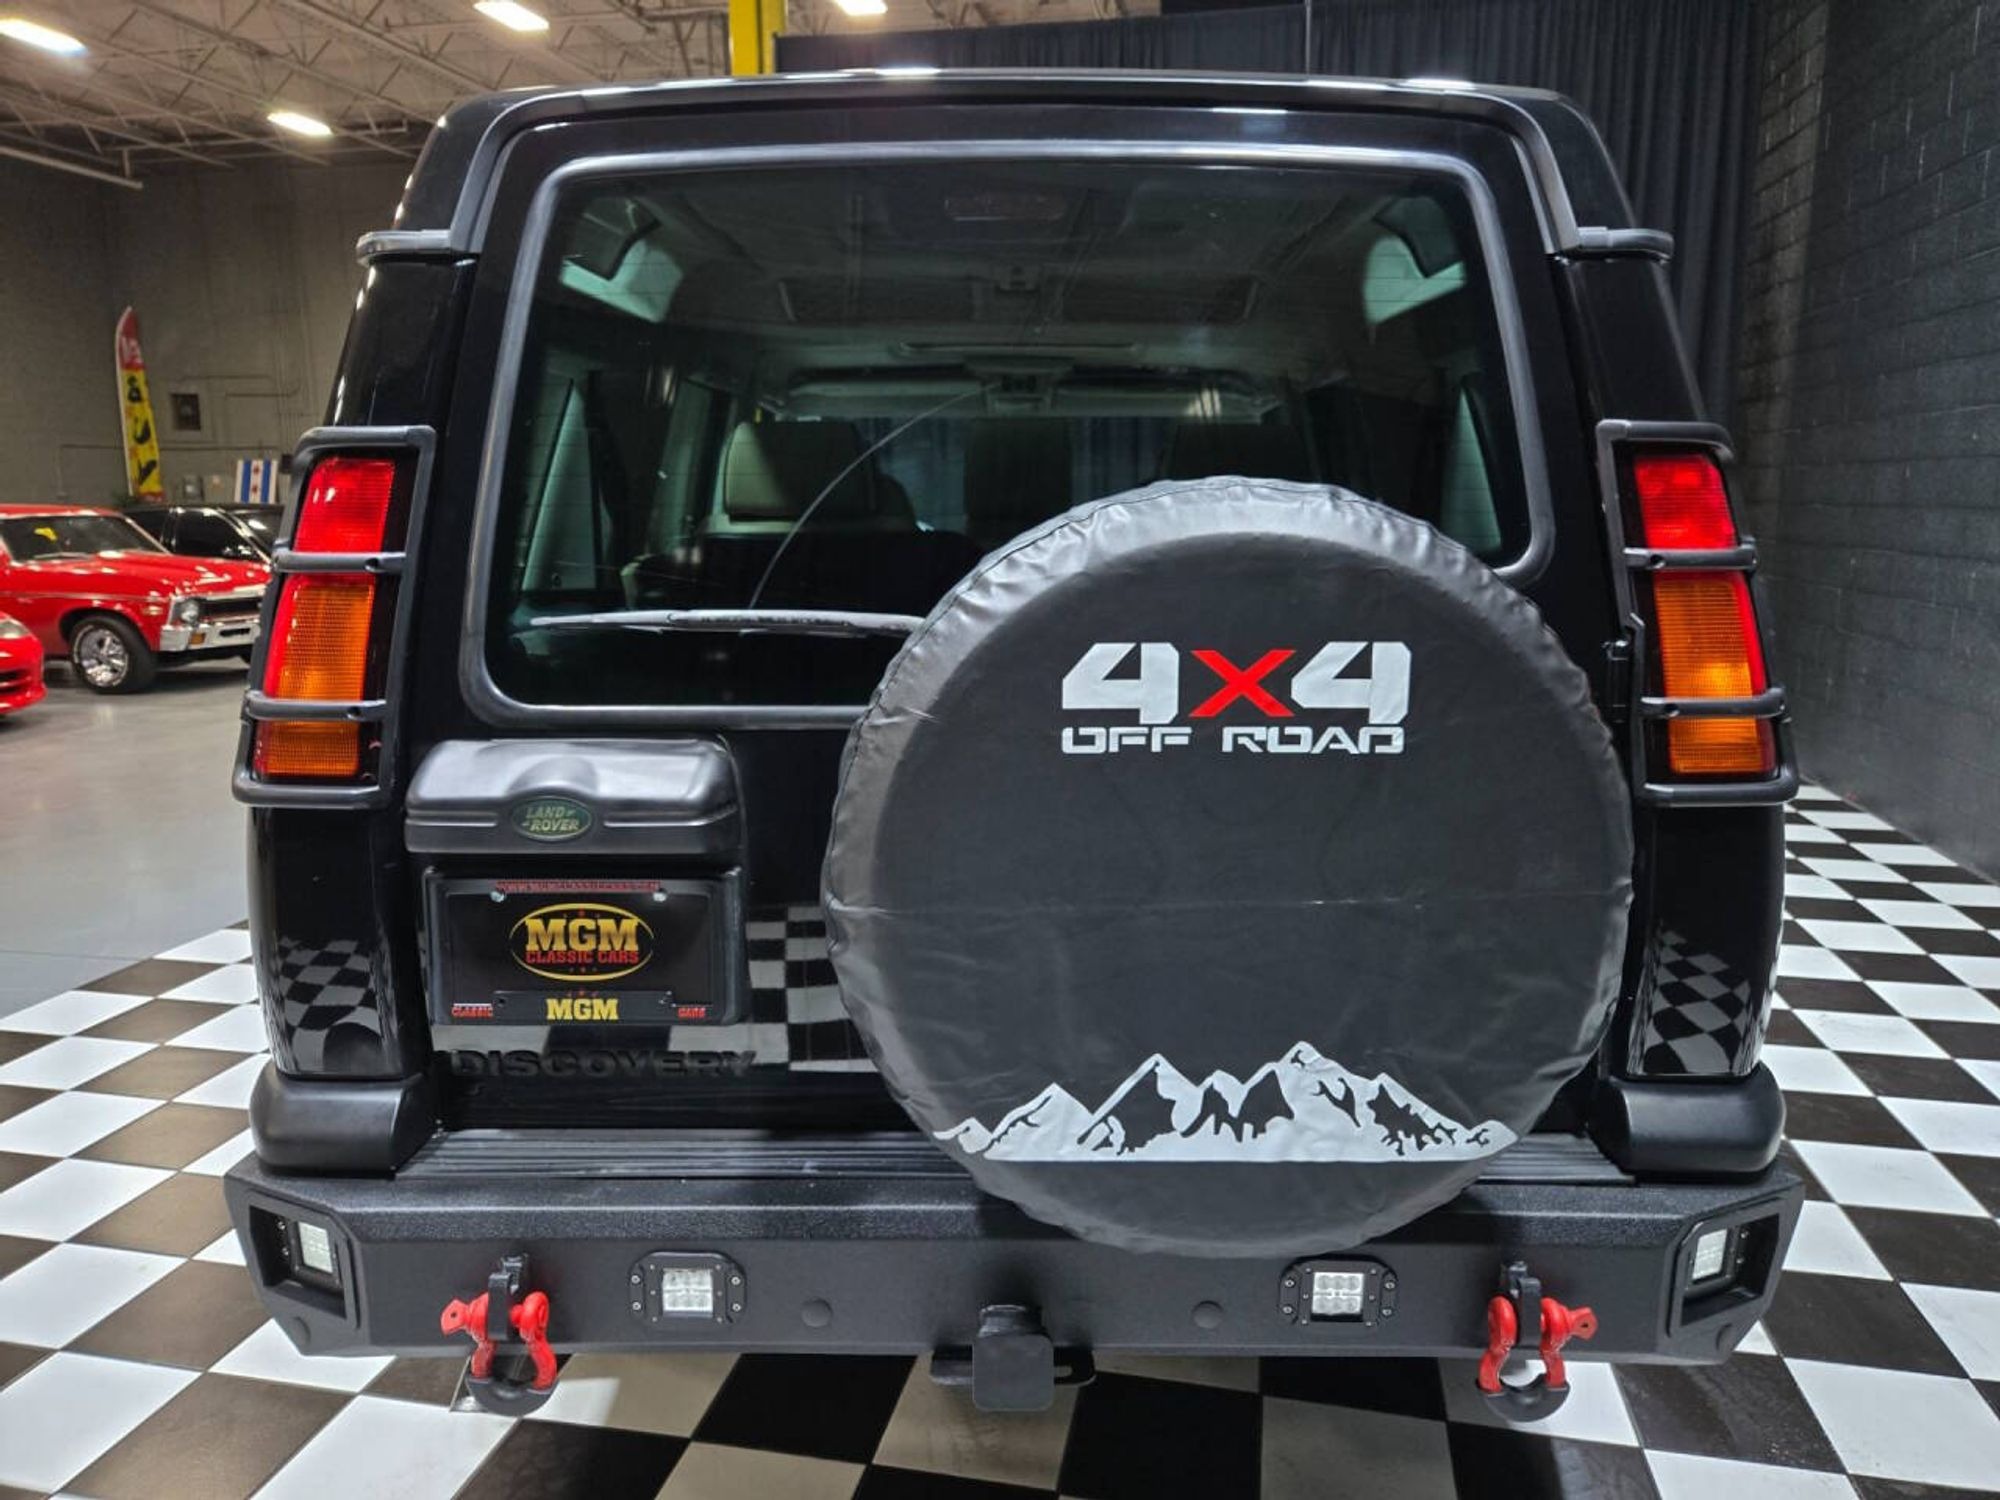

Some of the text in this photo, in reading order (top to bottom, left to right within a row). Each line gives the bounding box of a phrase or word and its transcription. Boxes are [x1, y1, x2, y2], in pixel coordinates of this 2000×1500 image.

[1061, 726, 1405, 754] OFF ROAD
[525, 806, 566, 819] LAND
[529, 818, 579, 832] ROVER
[525, 918, 640, 951] MGM
[525, 951, 640, 964] CLASSIC CARS
[546, 999, 620, 1020] MGM
[450, 1050, 756, 1077] DISCOVERY
